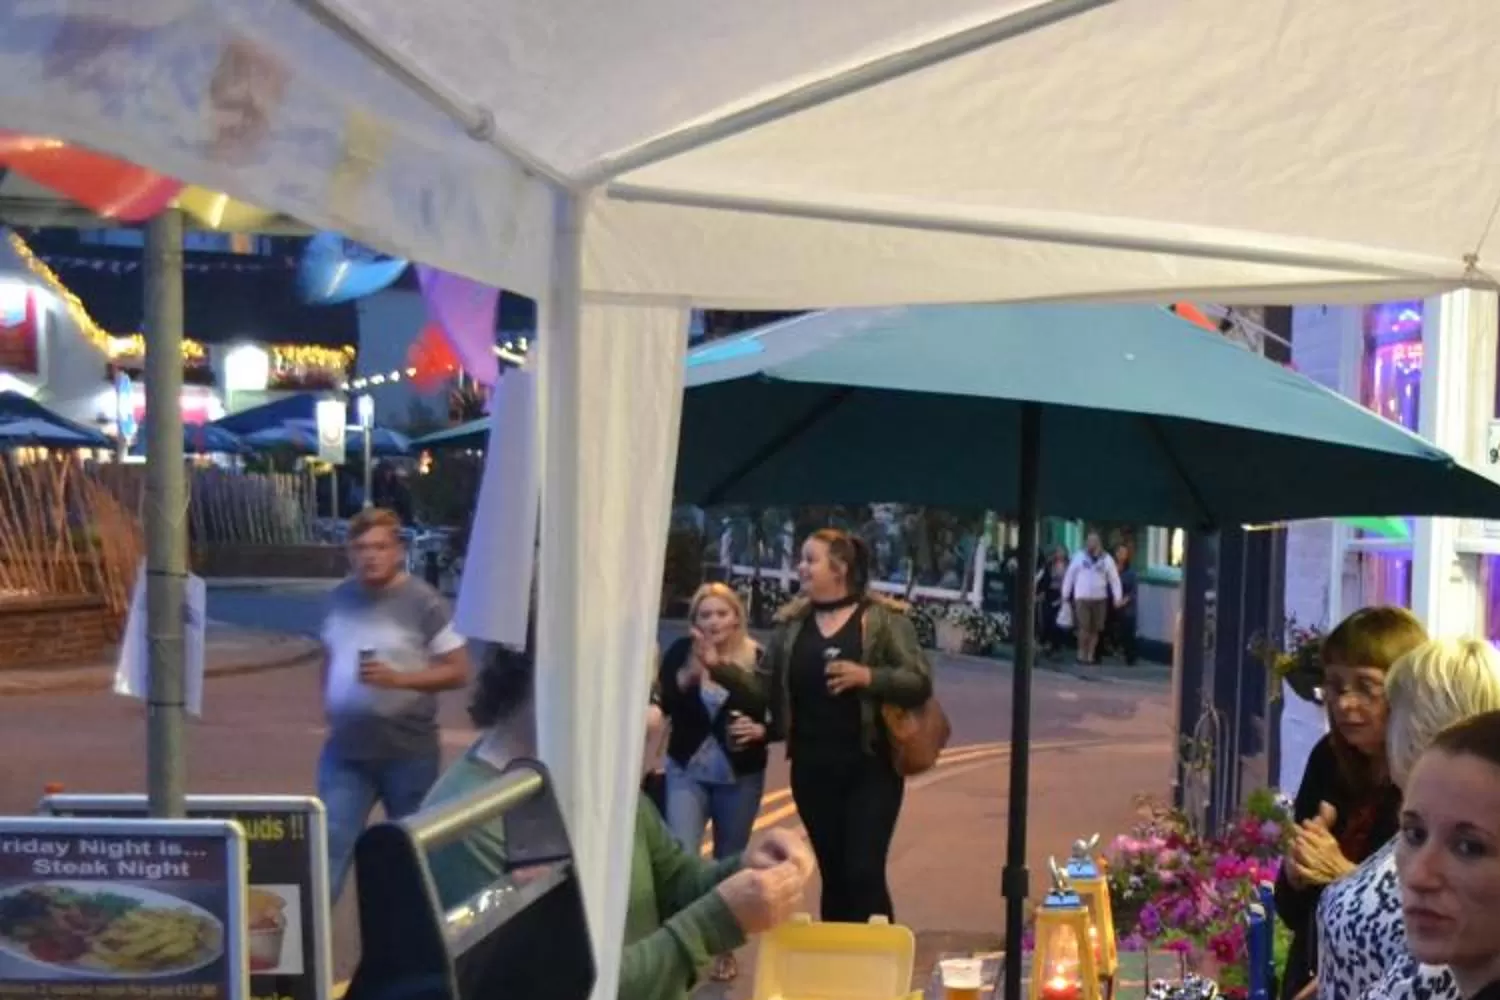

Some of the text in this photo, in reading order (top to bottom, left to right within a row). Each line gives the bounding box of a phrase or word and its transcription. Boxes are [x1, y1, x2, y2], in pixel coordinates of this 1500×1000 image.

[79, 839, 153, 859] Night
[32, 858, 191, 879] Steak Night
